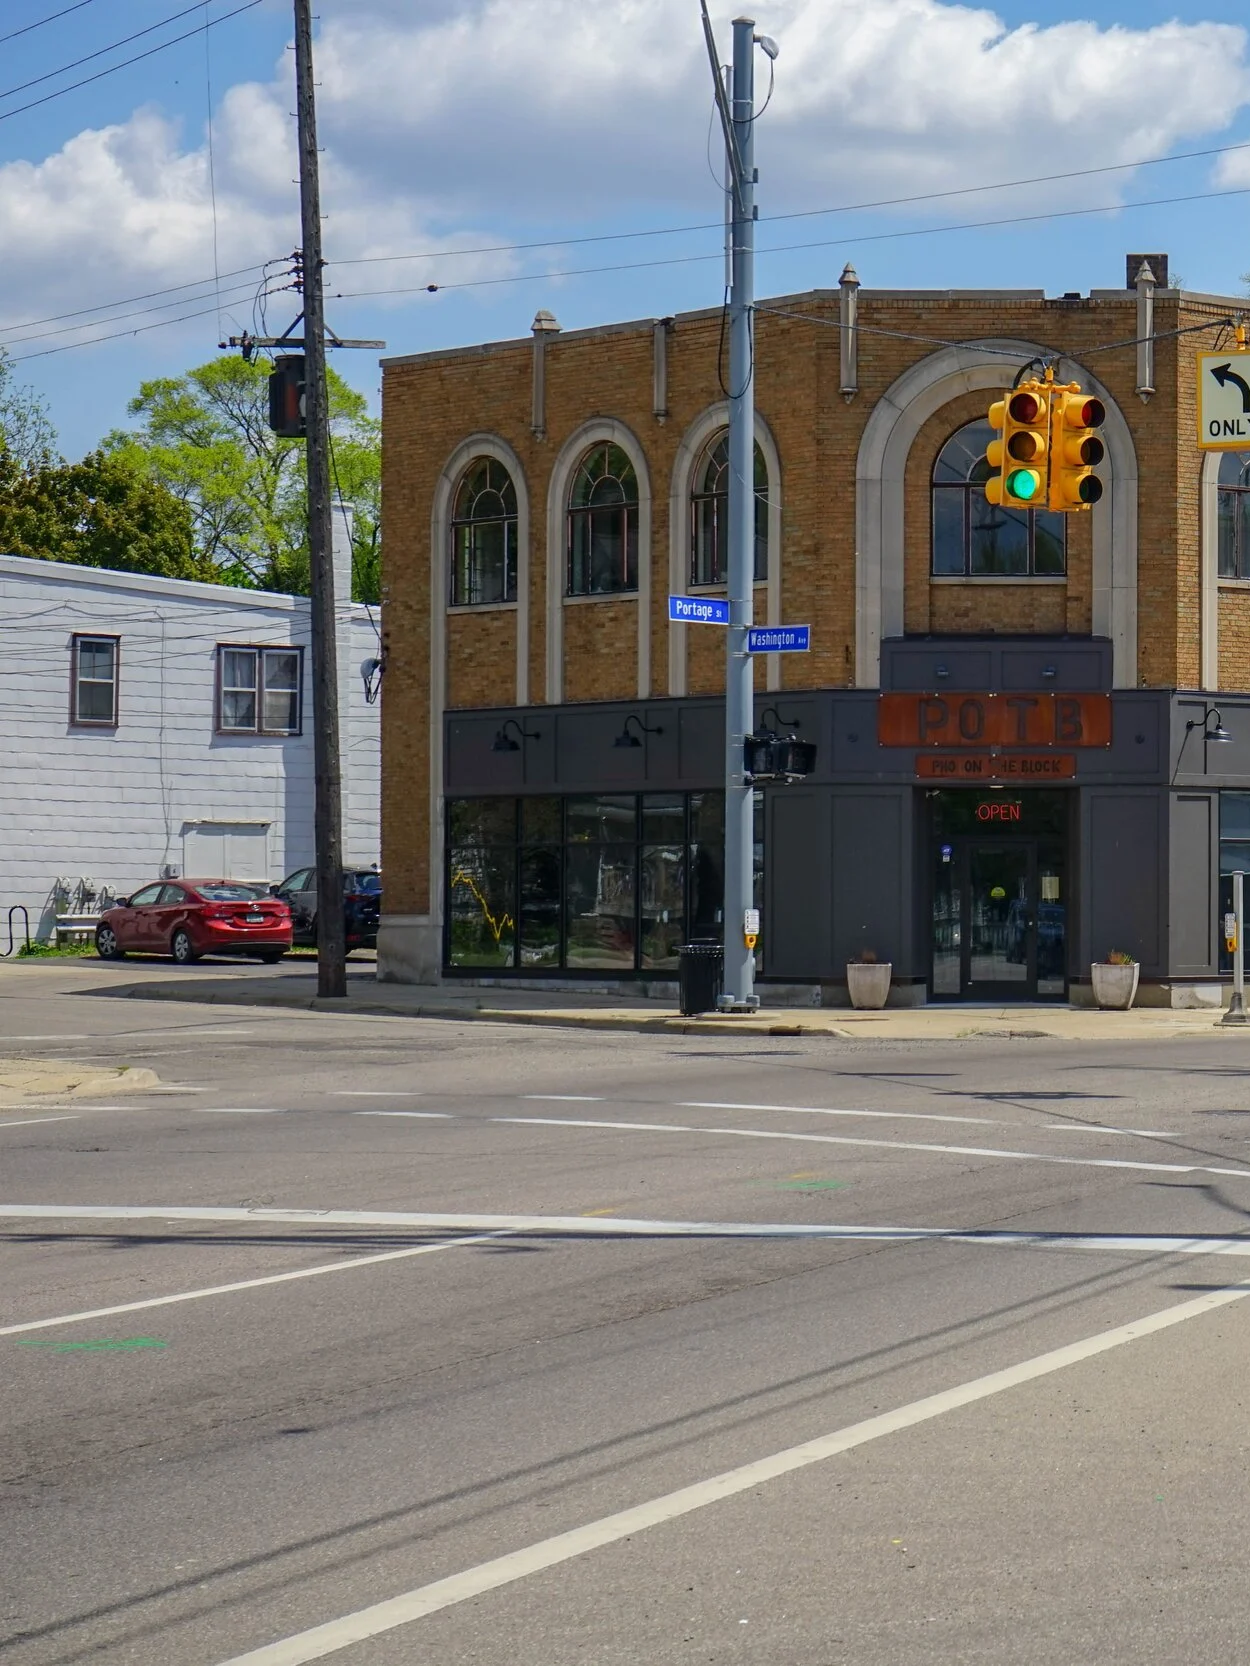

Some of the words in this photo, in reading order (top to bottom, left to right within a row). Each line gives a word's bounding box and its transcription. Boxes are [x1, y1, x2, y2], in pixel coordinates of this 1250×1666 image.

[676, 600, 712, 620] Portage
[751, 632, 795, 648] Washington
[964, 760, 982, 773] ON
[1021, 760, 1061, 773] BLOCK
[977, 804, 1021, 820] OPEN
